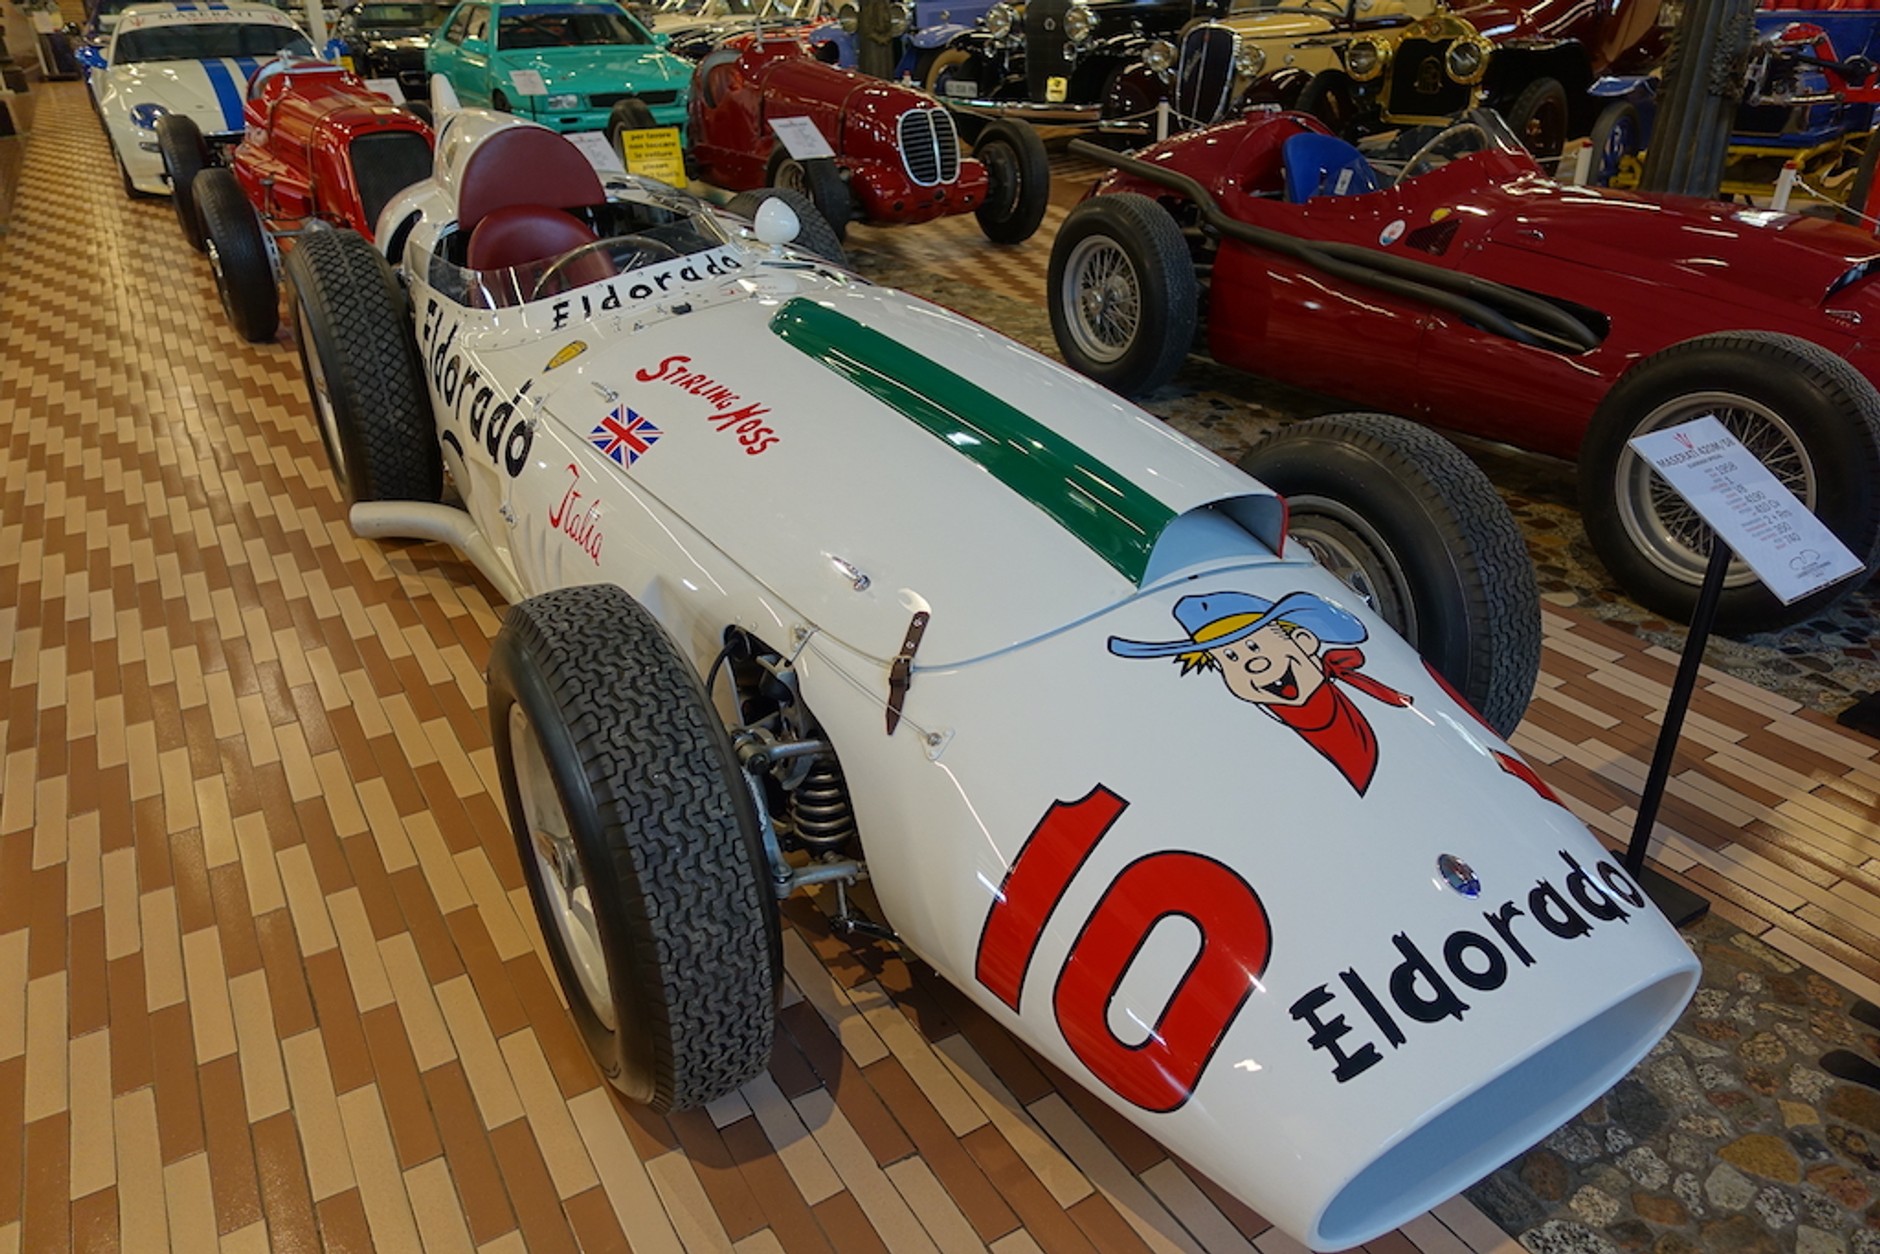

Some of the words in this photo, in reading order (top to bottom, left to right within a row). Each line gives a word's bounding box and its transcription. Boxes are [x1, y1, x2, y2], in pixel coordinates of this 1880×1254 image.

[551, 253, 742, 331] Eldorado
[423, 298, 534, 477] Eldorado
[549, 463, 603, 567] Italia
[1656, 449, 1700, 468] MASERATI
[975, 783, 1273, 1114] 10
[1288, 849, 1645, 1083] Eldorado
